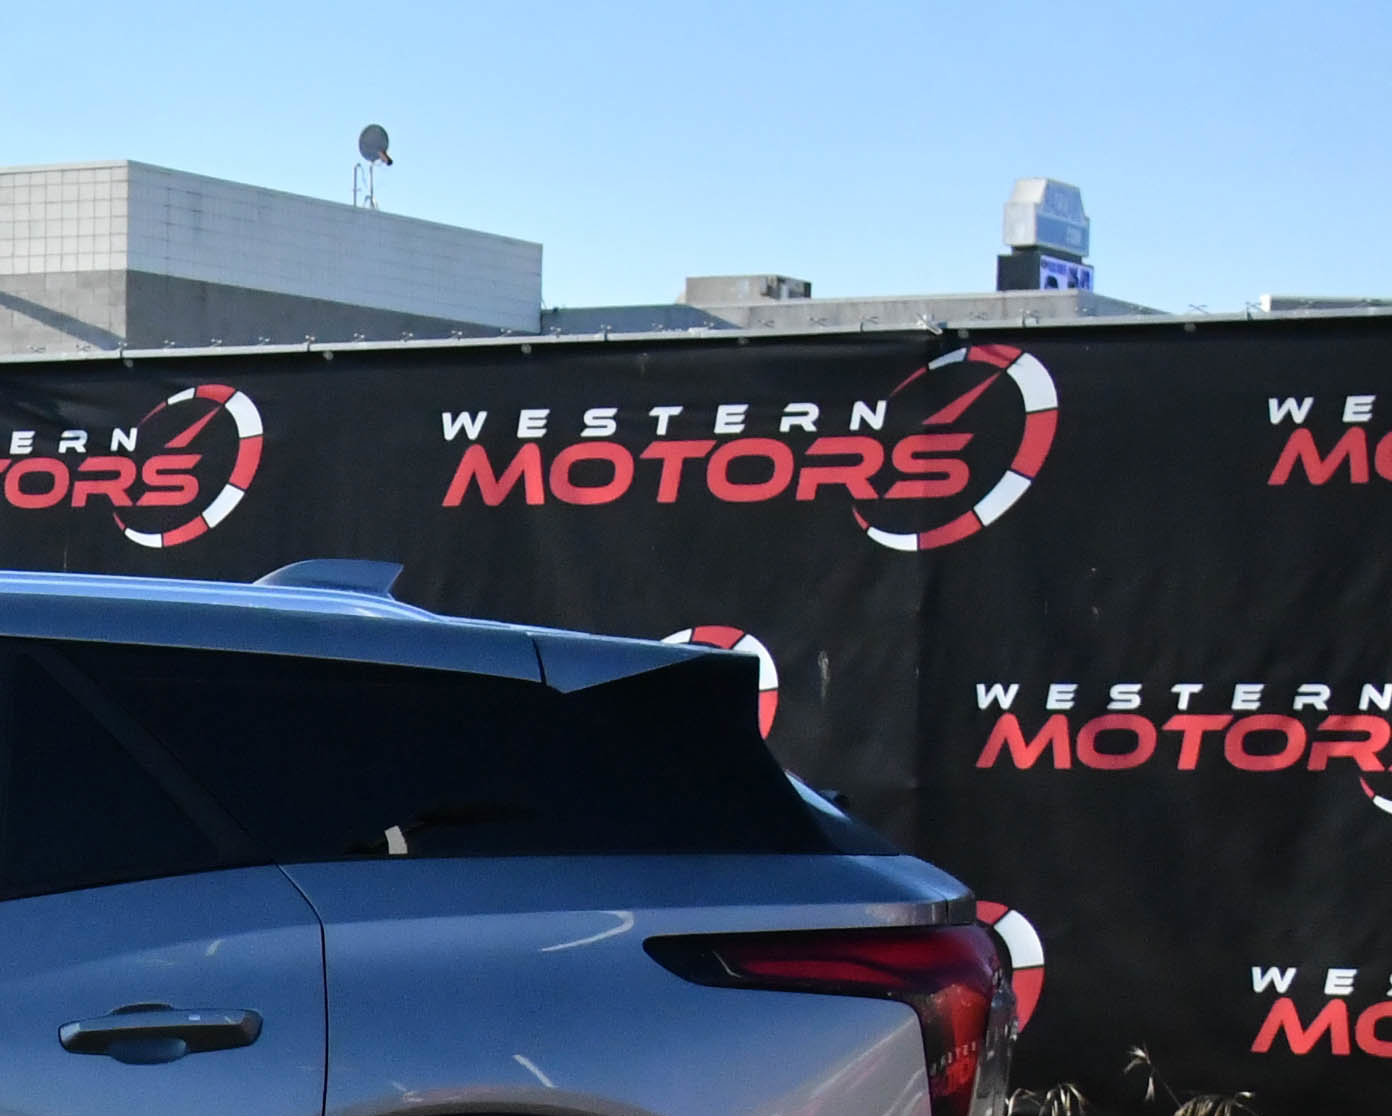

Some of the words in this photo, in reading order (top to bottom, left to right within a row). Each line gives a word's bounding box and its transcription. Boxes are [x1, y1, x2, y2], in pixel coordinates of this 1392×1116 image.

[441, 400, 887, 441] WESTERN
[442, 433, 973, 508] MOTORS
[976, 683, 1392, 711] WESTERN
[975, 712, 1392, 772] MOTOR
